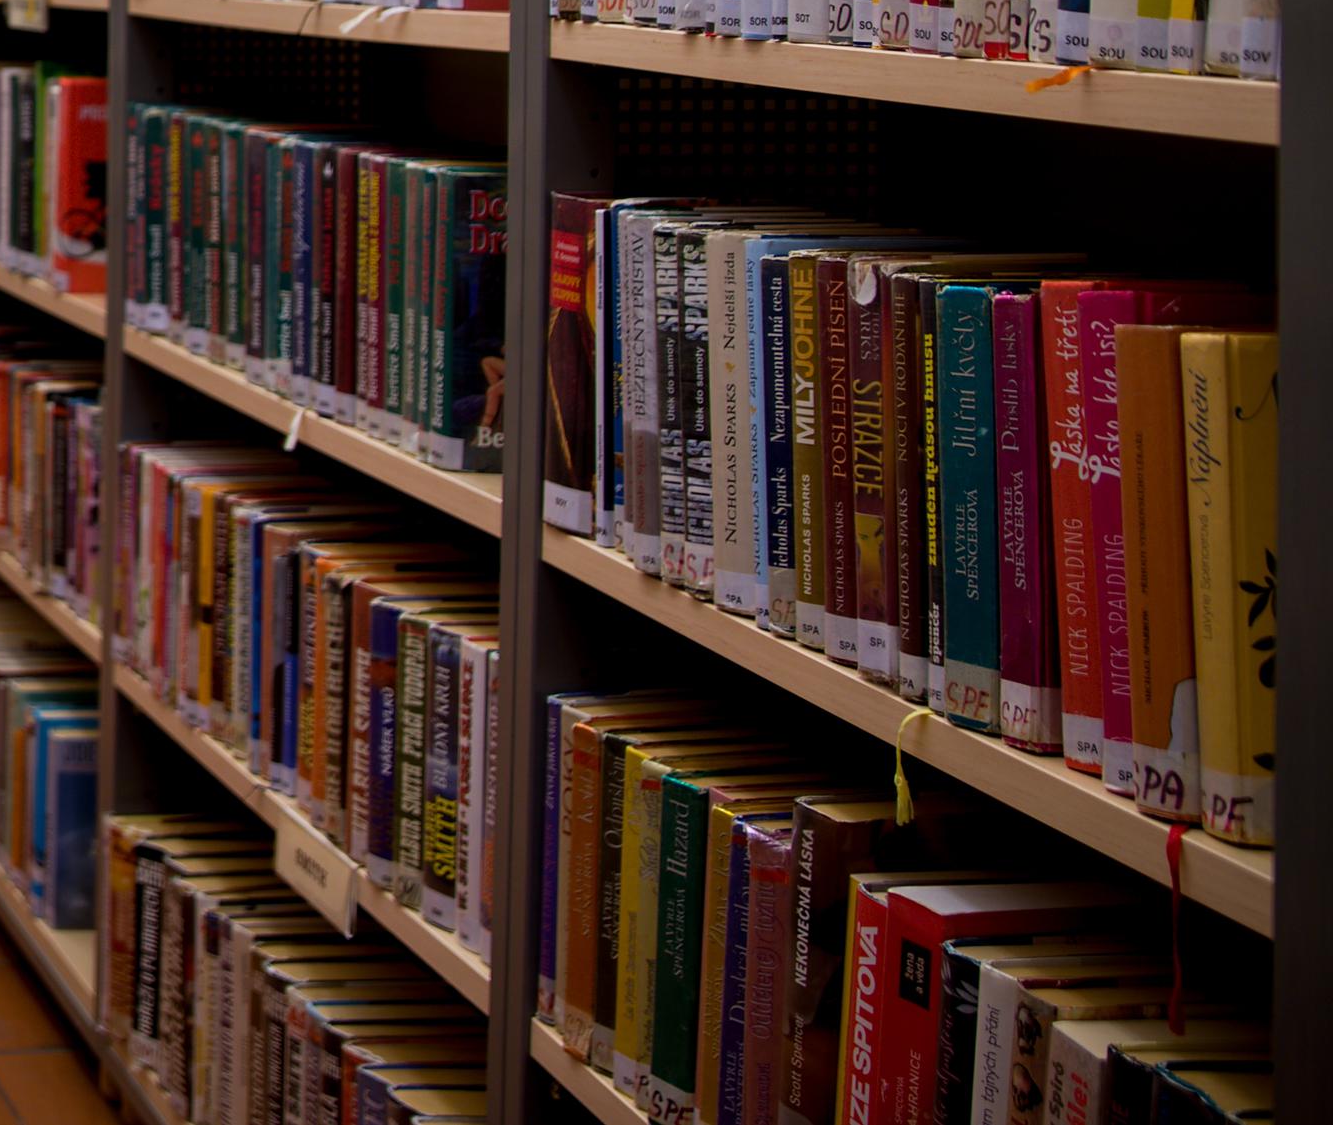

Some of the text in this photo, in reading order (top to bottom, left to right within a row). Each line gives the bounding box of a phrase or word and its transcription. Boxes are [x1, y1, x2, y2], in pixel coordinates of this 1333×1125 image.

[750, 16, 768, 26] SOR
[796, 13, 810, 23] SOT
[915, 27, 931, 39] SOU
[1099, 45, 1125, 59] SOU
[684, 245, 709, 340] SPARKS
[723, 252, 736, 350] Nejdelší jízda
[665, 337, 677, 377] samoty
[770, 277, 787, 443] Nezapomenutelná cesta
[894, 293, 906, 387] RODANTHE
[1058, 308, 1078, 359] třetí
[695, 347, 705, 387] samoty
[828, 280, 847, 478] POSLEDNÍ PÍSEŇ
[924, 333, 934, 402] hnusu
[724, 384, 737, 543] NICHOLAS SPARKS
[1189, 371, 1221, 505] Naplnění
[770, 467, 789, 515] Sparks
[801, 474, 812, 594] NICHOLAS SPARKS
[834, 501, 845, 612] NICHOLAS SPARKS
[966, 489, 979, 600] SPENCEROVÁ
[1012, 471, 1026, 590] SPENCEROVÁ
[898, 488, 910, 640] NICHOLAS SPARKS
[1064, 517, 1089, 677] NICK SPALDING
[726, 593, 742, 605] SPA
[803, 623, 819, 636] SPA
[1105, 532, 1131, 697] NICK SPALDING
[839, 639, 856, 652] SPA
[435, 665, 450, 714] KRUH
[946, 682, 989, 721] SPE
[1077, 740, 1099, 755] SPA
[402, 763, 422, 815] SMITH
[433, 795, 456, 879] SMITH
[666, 800, 690, 877] Hazard
[795, 829, 815, 987] NEKONEČNÁ LÁSKA
[904, 952, 914, 979] žena
[915, 957, 925, 983] věda
[853, 925, 878, 1075] SPITOVÁ
[985, 1004, 1001, 1047] přání
[789, 1014, 805, 1106] Scott Spencer
[908, 1049, 921, 1115] HRANICE
[981, 1052, 1000, 1102] tajných
[649, 1088, 694, 1124] SPE
